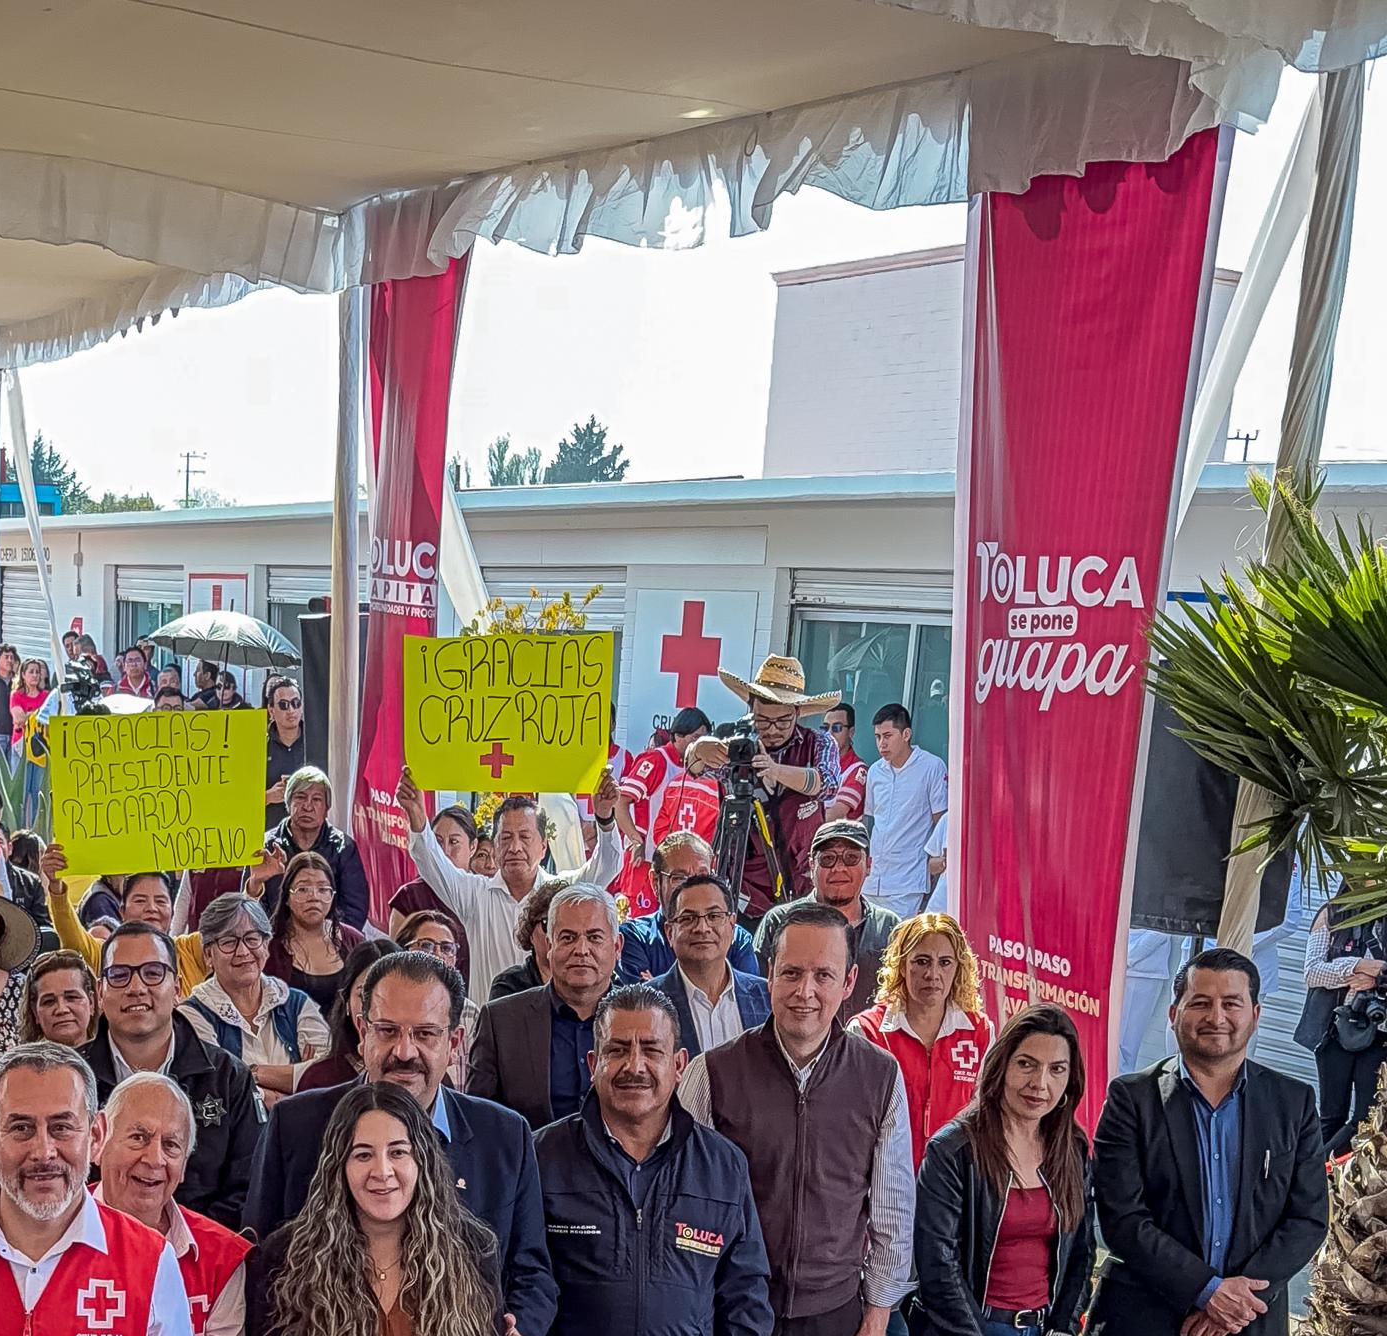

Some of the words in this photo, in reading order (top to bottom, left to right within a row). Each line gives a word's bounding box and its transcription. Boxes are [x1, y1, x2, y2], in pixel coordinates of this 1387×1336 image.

[976, 541, 1144, 609] TOLUCA
[1010, 615, 1027, 630] se
[1030, 613, 1074, 633] pone
[974, 638, 1136, 711] guapa
[419, 694, 511, 745] CRUZ
[515, 690, 603, 747] ROJA
[68, 753, 230, 798] PRESIDENTE
[62, 788, 192, 840] RICARDO
[151, 826, 246, 870] MORENO
[988, 934, 1025, 960] PASO
[1026, 946, 1033, 965] A
[1034, 949, 1071, 977] PASO
[981, 959, 1100, 1017] TRANSFORMACIÓN
[675, 1222, 724, 1246] TOLUCA
